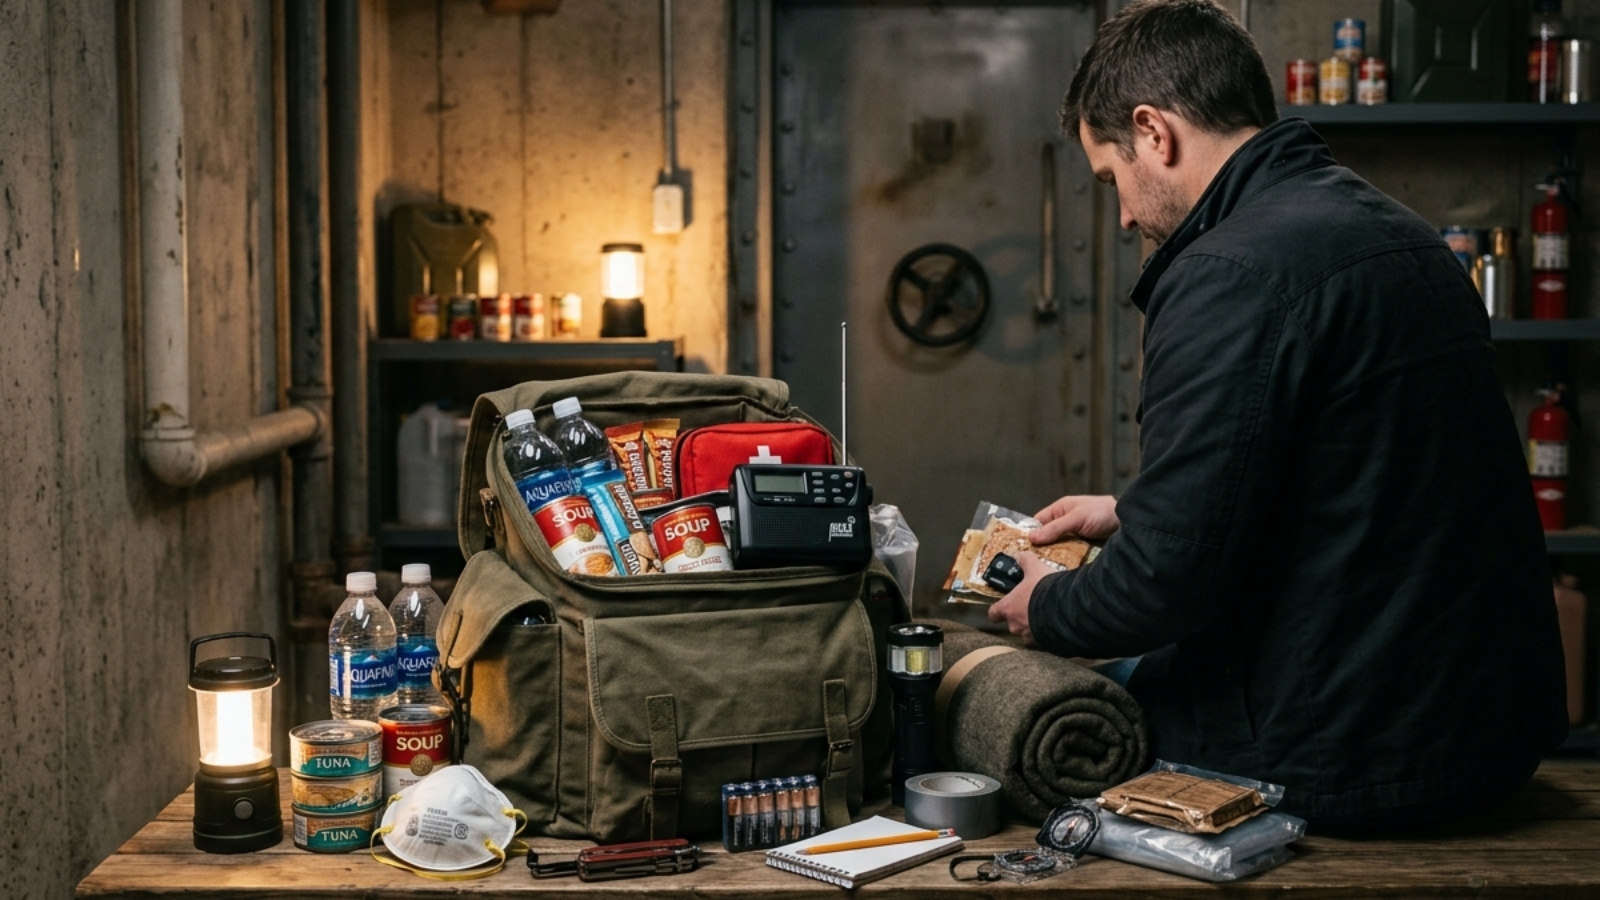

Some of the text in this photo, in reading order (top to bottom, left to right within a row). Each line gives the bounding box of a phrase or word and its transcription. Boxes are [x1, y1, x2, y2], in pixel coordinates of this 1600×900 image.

[552, 506, 594, 528] SOUP
[664, 518, 710, 541] SOUP
[396, 734, 443, 751] SOUP
[316, 758, 351, 768] TUNA
[321, 830, 358, 841] TUNA
